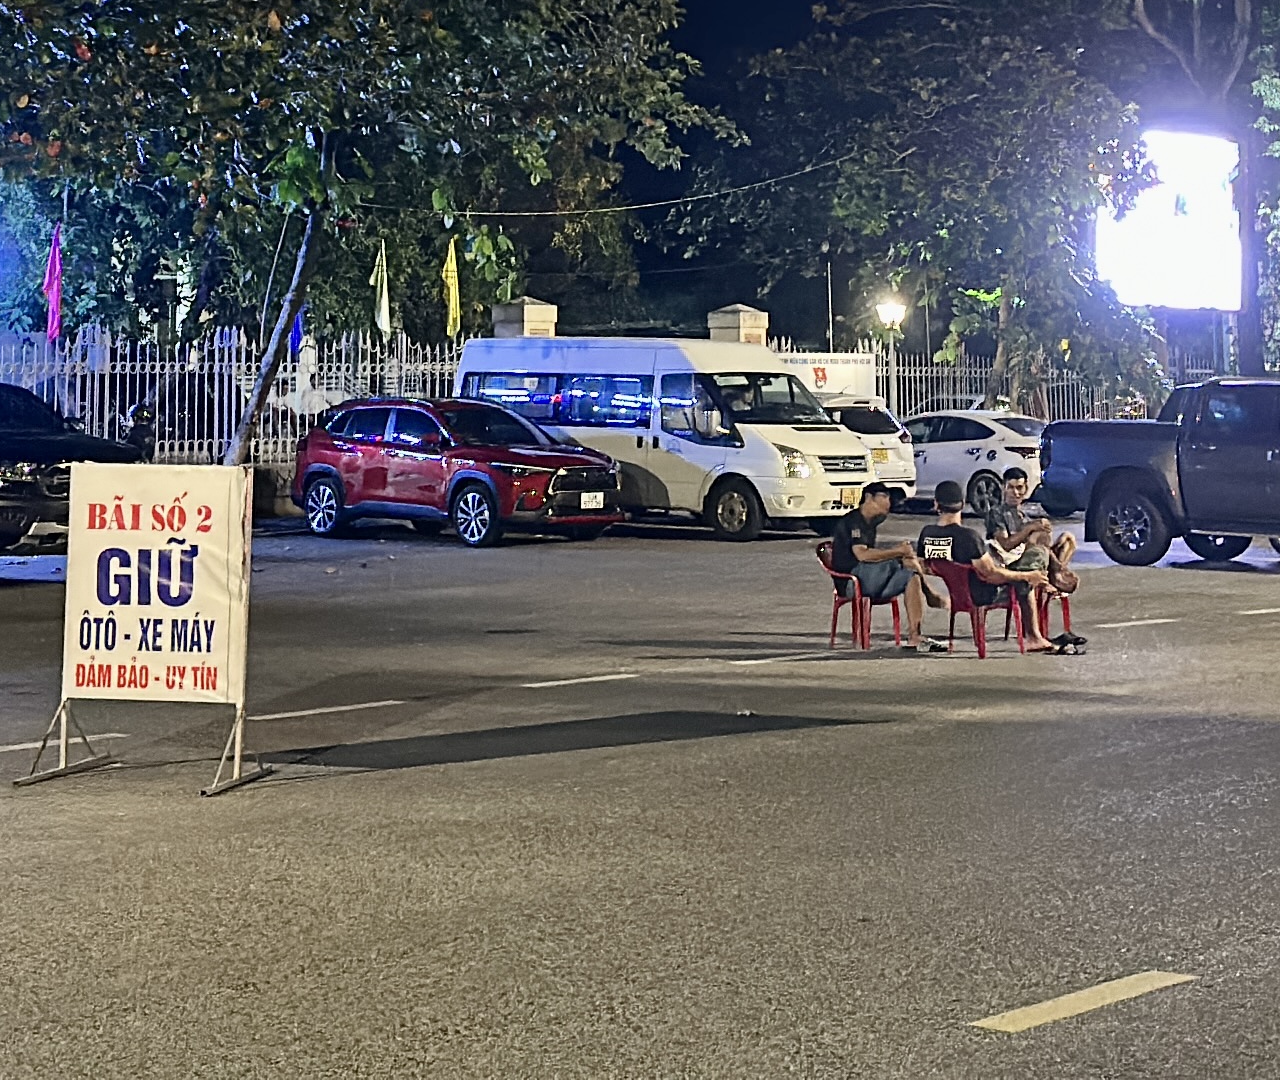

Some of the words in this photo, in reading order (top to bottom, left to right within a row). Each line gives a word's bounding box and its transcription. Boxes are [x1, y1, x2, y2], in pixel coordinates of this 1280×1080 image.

[86, 495, 143, 531] BÃI
[151, 491, 188, 533] SỐ
[195, 505, 213, 533] 2
[96, 536, 200, 607] GIỮ
[78, 609, 117, 651] ÔTÔ
[137, 617, 163, 652] XE
[170, 611, 215, 653] MÁY
[75, 655, 111, 688] ĐẢM
[116, 656, 149, 689] BẢO
[191, 661, 217, 690] TÍN
